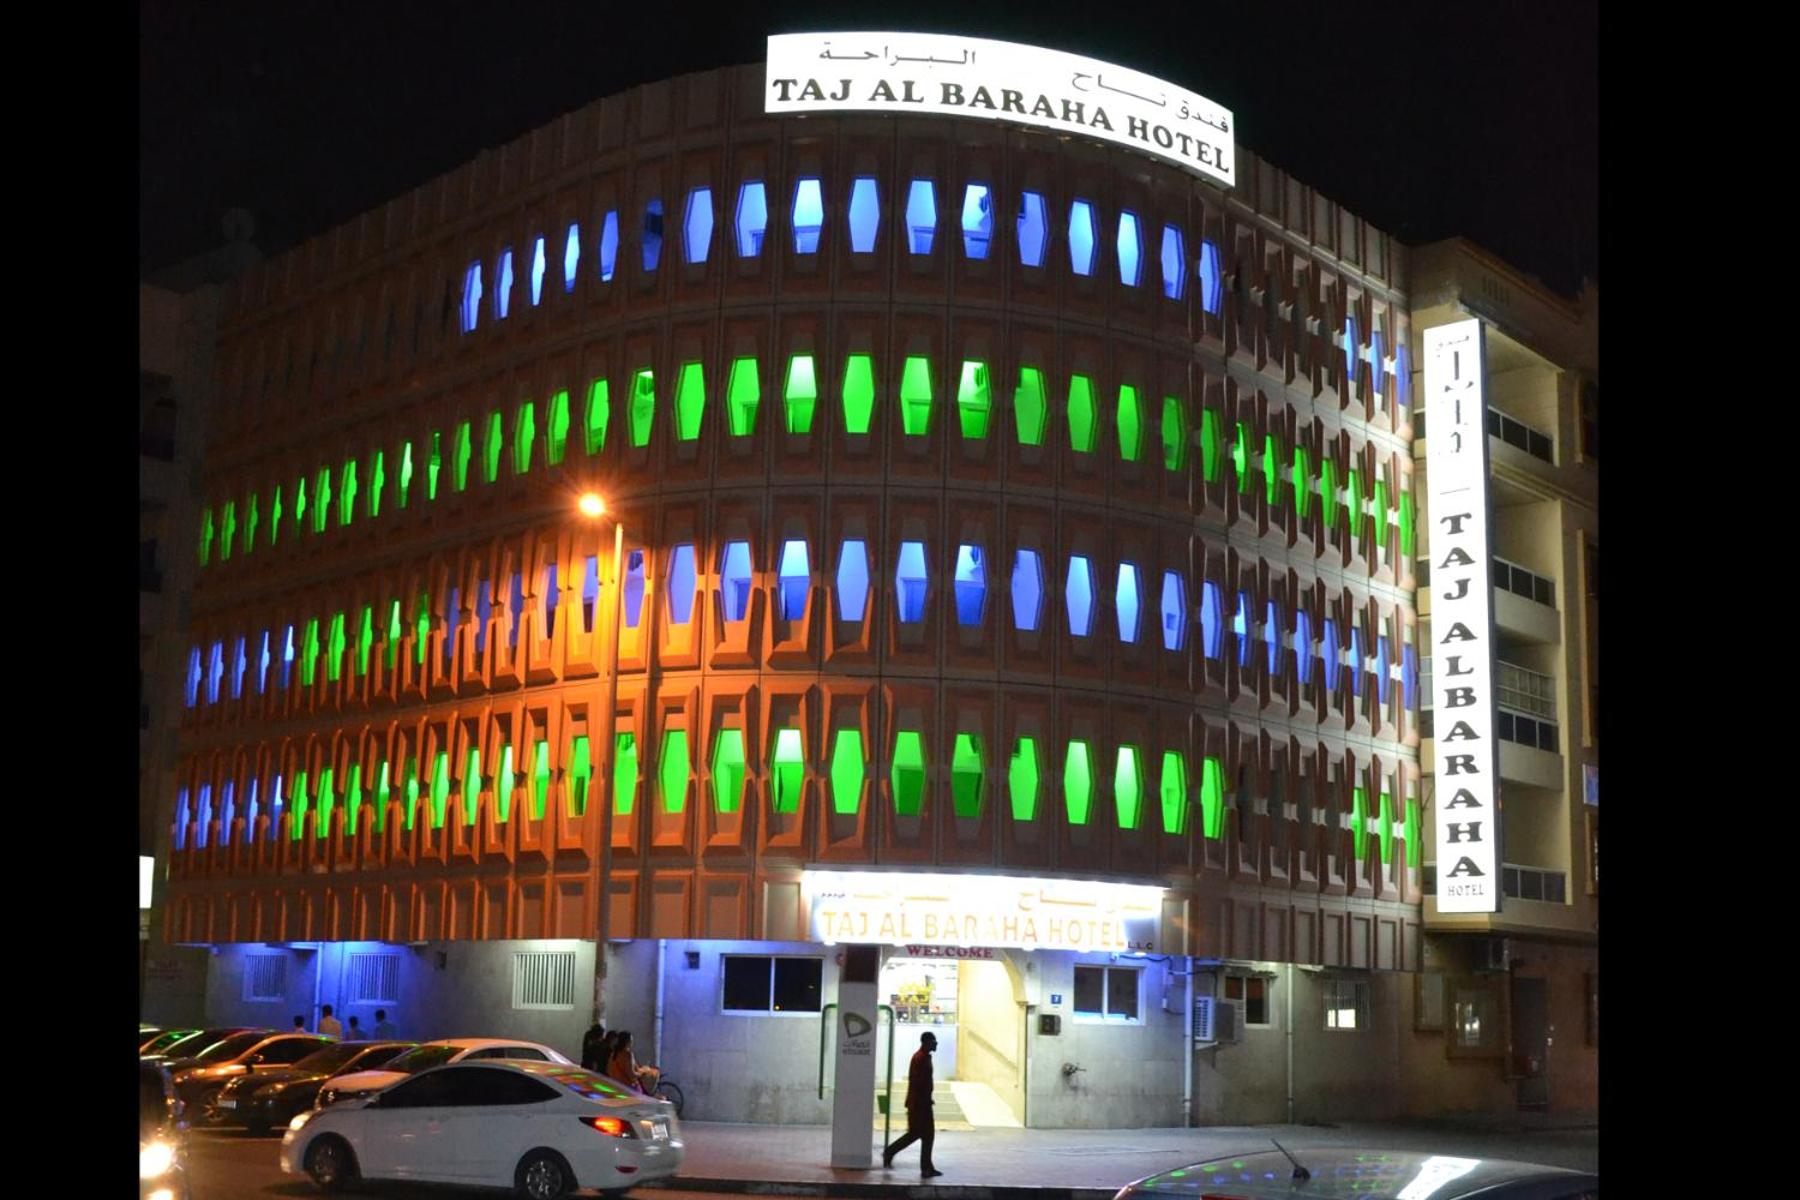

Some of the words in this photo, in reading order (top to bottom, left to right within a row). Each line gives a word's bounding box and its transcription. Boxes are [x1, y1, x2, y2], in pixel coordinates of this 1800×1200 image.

[819, 41, 976, 69] البراحة
[773, 79, 853, 102] TAJ
[867, 80, 925, 103] AL
[941, 83, 1115, 132] BARAHA
[1128, 116, 1230, 173] HOTEL
[1174, 99, 1229, 134] فندق
[1439, 512, 1475, 600] TAJ
[1448, 884, 1484, 897] HOTEL
[822, 910, 868, 937] TAJ
[879, 911, 912, 938] AL
[1049, 917, 1124, 947] HOTEL
[906, 944, 993, 958] WELCOME
